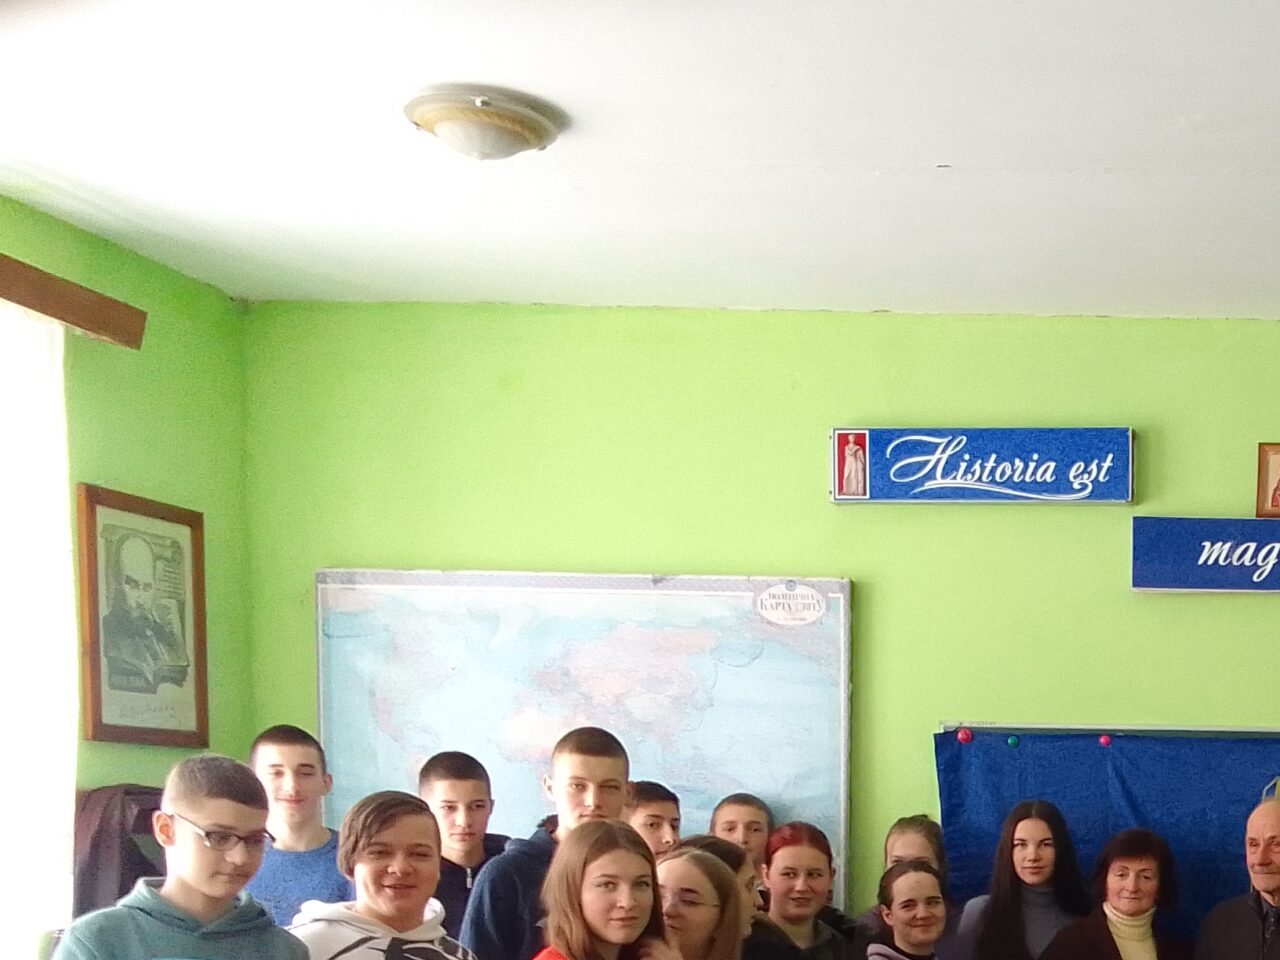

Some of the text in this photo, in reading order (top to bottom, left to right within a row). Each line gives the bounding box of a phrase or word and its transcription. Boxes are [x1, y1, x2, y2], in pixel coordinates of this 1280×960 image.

[887, 435, 1114, 490] Historia est
[760, 598, 793, 611] КАРТА
